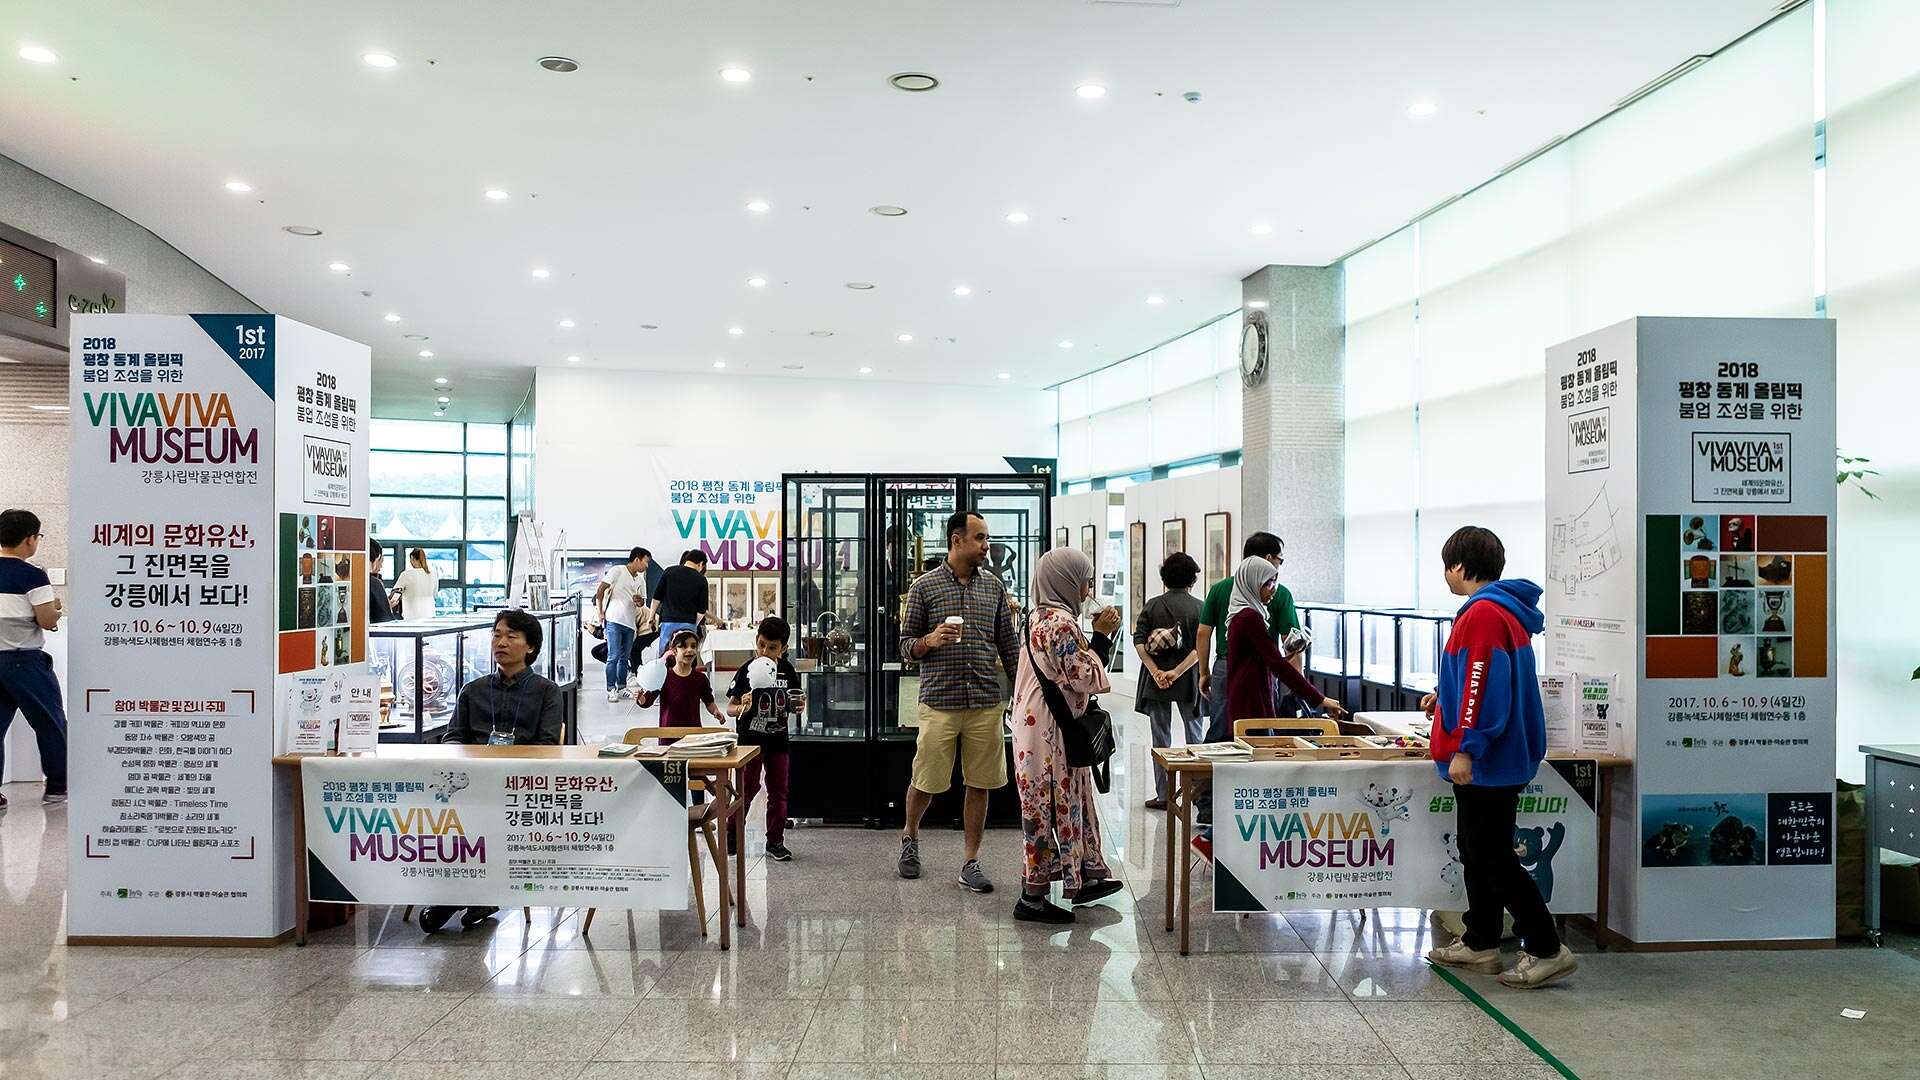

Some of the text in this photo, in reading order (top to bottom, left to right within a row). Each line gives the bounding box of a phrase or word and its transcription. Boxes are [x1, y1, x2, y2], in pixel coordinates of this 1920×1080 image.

[235, 324, 266, 346] 1st
[83, 338, 116, 350] 2018
[83, 353, 184, 367] 평창 동계 올림픽
[239, 348, 265, 360] 2017
[1577, 348, 1597, 367] 2018
[83, 369, 184, 383] 붐업 조성을 위한
[1560, 360, 1618, 391] 평창 동계 올림픽
[1718, 362, 1759, 378] 2018
[316, 371, 337, 390] 2018
[1577, 385, 1599, 405] 조성을
[1601, 380, 1618, 398] 위한
[1678, 381, 1802, 400] 평창 동계 올림픽
[297, 385, 357, 414] 평창 동계 올림픽
[83, 392, 236, 427] VIVAVIVA
[1679, 402, 1803, 420] 붐업 조성을 위한
[315, 409, 339, 429] 조성을
[341, 415, 357, 432] 위한
[110, 428, 258, 464] MUSEUM
[1575, 428, 1606, 447] MUSEUM
[1698, 441, 1783, 456] VIVAVIVA 1st
[312, 460, 347, 478] MUSEUM
[1710, 456, 1783, 472] MUSEUM
[141, 470, 258, 485] 강릉사립박물관연합전
[670, 480, 699, 491] 2018
[702, 480, 724, 492] 평창
[728, 481, 750, 492] 동계
[697, 492, 730, 504] 조성을
[734, 493, 755, 504] 위한
[91, 523, 256, 549] 세계의 문화유산,
[116, 554, 231, 579] 그 진면목을
[105, 583, 248, 608] 강릉에서 보다!
[1470, 661, 1484, 695] WHAT
[115, 700, 225, 712] 참여 박물관 및 전시 주제
[662, 761, 682, 774] 1st
[1573, 763, 1593, 777] 1st
[323, 782, 425, 793] 2018 평창 동계 올림픽
[504, 776, 618, 792] 세계의 문화유산,
[664, 776, 681, 784] 2017
[345, 792, 374, 803] 조성을
[377, 793, 397, 803] 위한
[1234, 786, 1338, 799] 2018 평창 동계 올림픽
[174, 800, 208, 808] Timeless
[210, 800, 228, 808] Time
[505, 793, 584, 810] 그 진면목을
[1258, 799, 1287, 810] 조성을
[1290, 798, 1309, 808] 위한
[1788, 801, 1814, 813] 독도는
[324, 807, 464, 835] VIVAVIVA
[505, 810, 604, 827] 강릉에서 보다!
[1234, 812, 1375, 841] VIVAVIVA
[1777, 817, 1825, 828] 대한민국의
[350, 833, 486, 864] MUSEUM
[1260, 838, 1395, 870] MUSEUM
